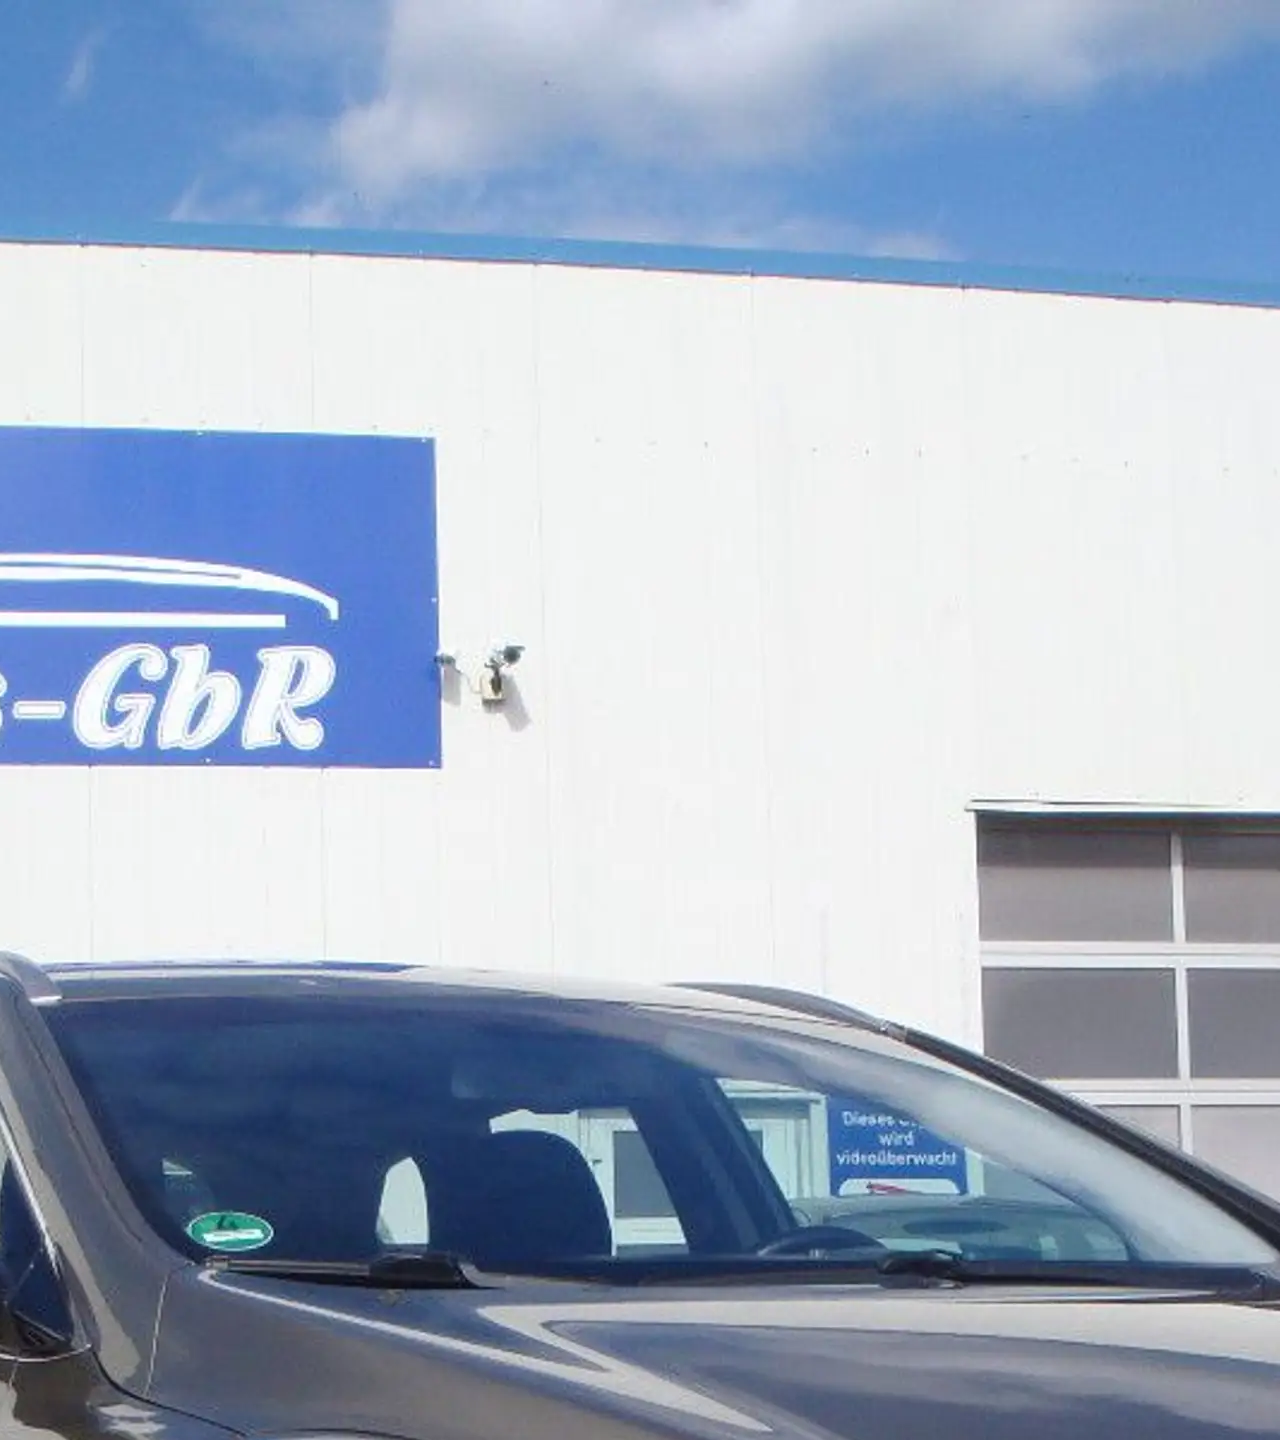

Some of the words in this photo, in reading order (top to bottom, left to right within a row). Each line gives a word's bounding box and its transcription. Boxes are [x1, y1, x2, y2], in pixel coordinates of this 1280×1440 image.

[842, 1110, 895, 1127] Dieses
[878, 1130, 915, 1146] wird
[836, 1149, 957, 1166] videoüberwacht
